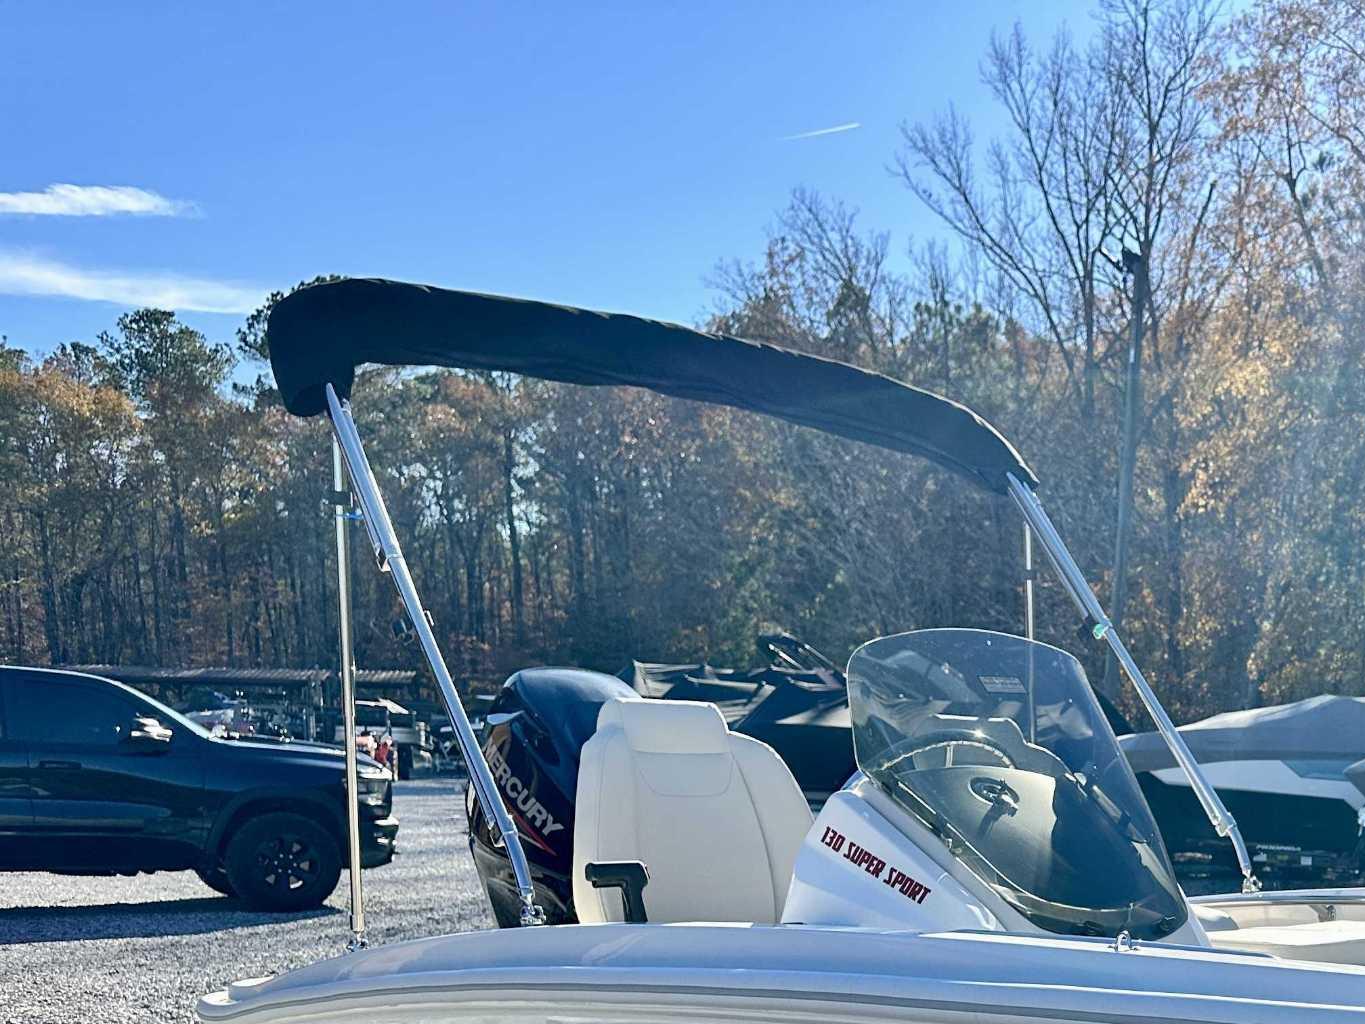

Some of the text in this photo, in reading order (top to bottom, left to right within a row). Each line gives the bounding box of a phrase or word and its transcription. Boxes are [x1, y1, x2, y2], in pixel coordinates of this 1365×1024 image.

[820, 826, 932, 904] 130 SUPER SPORT
